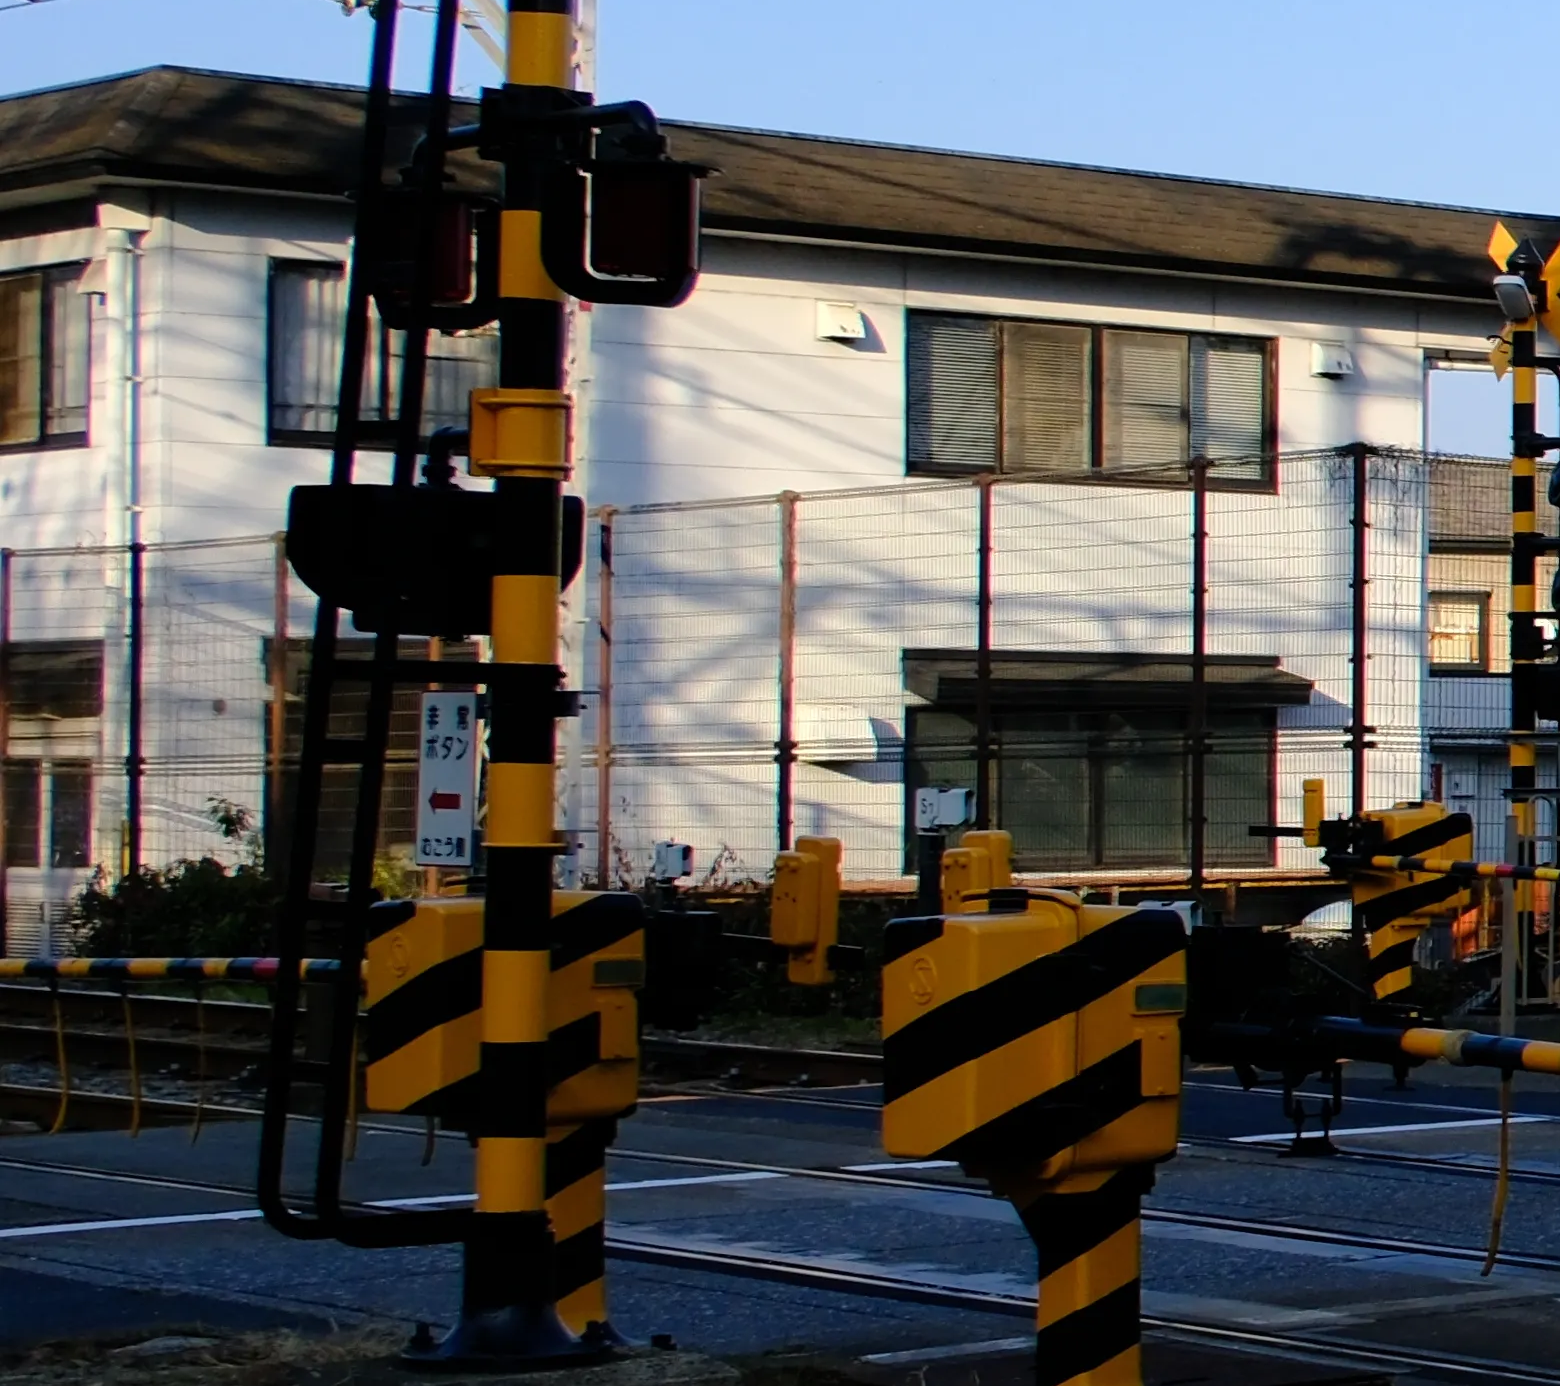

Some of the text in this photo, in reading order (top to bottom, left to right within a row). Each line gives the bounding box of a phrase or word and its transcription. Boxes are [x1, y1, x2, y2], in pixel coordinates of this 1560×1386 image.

[425, 734, 468, 760] ボタン
[420, 837, 466, 857] むこう側
